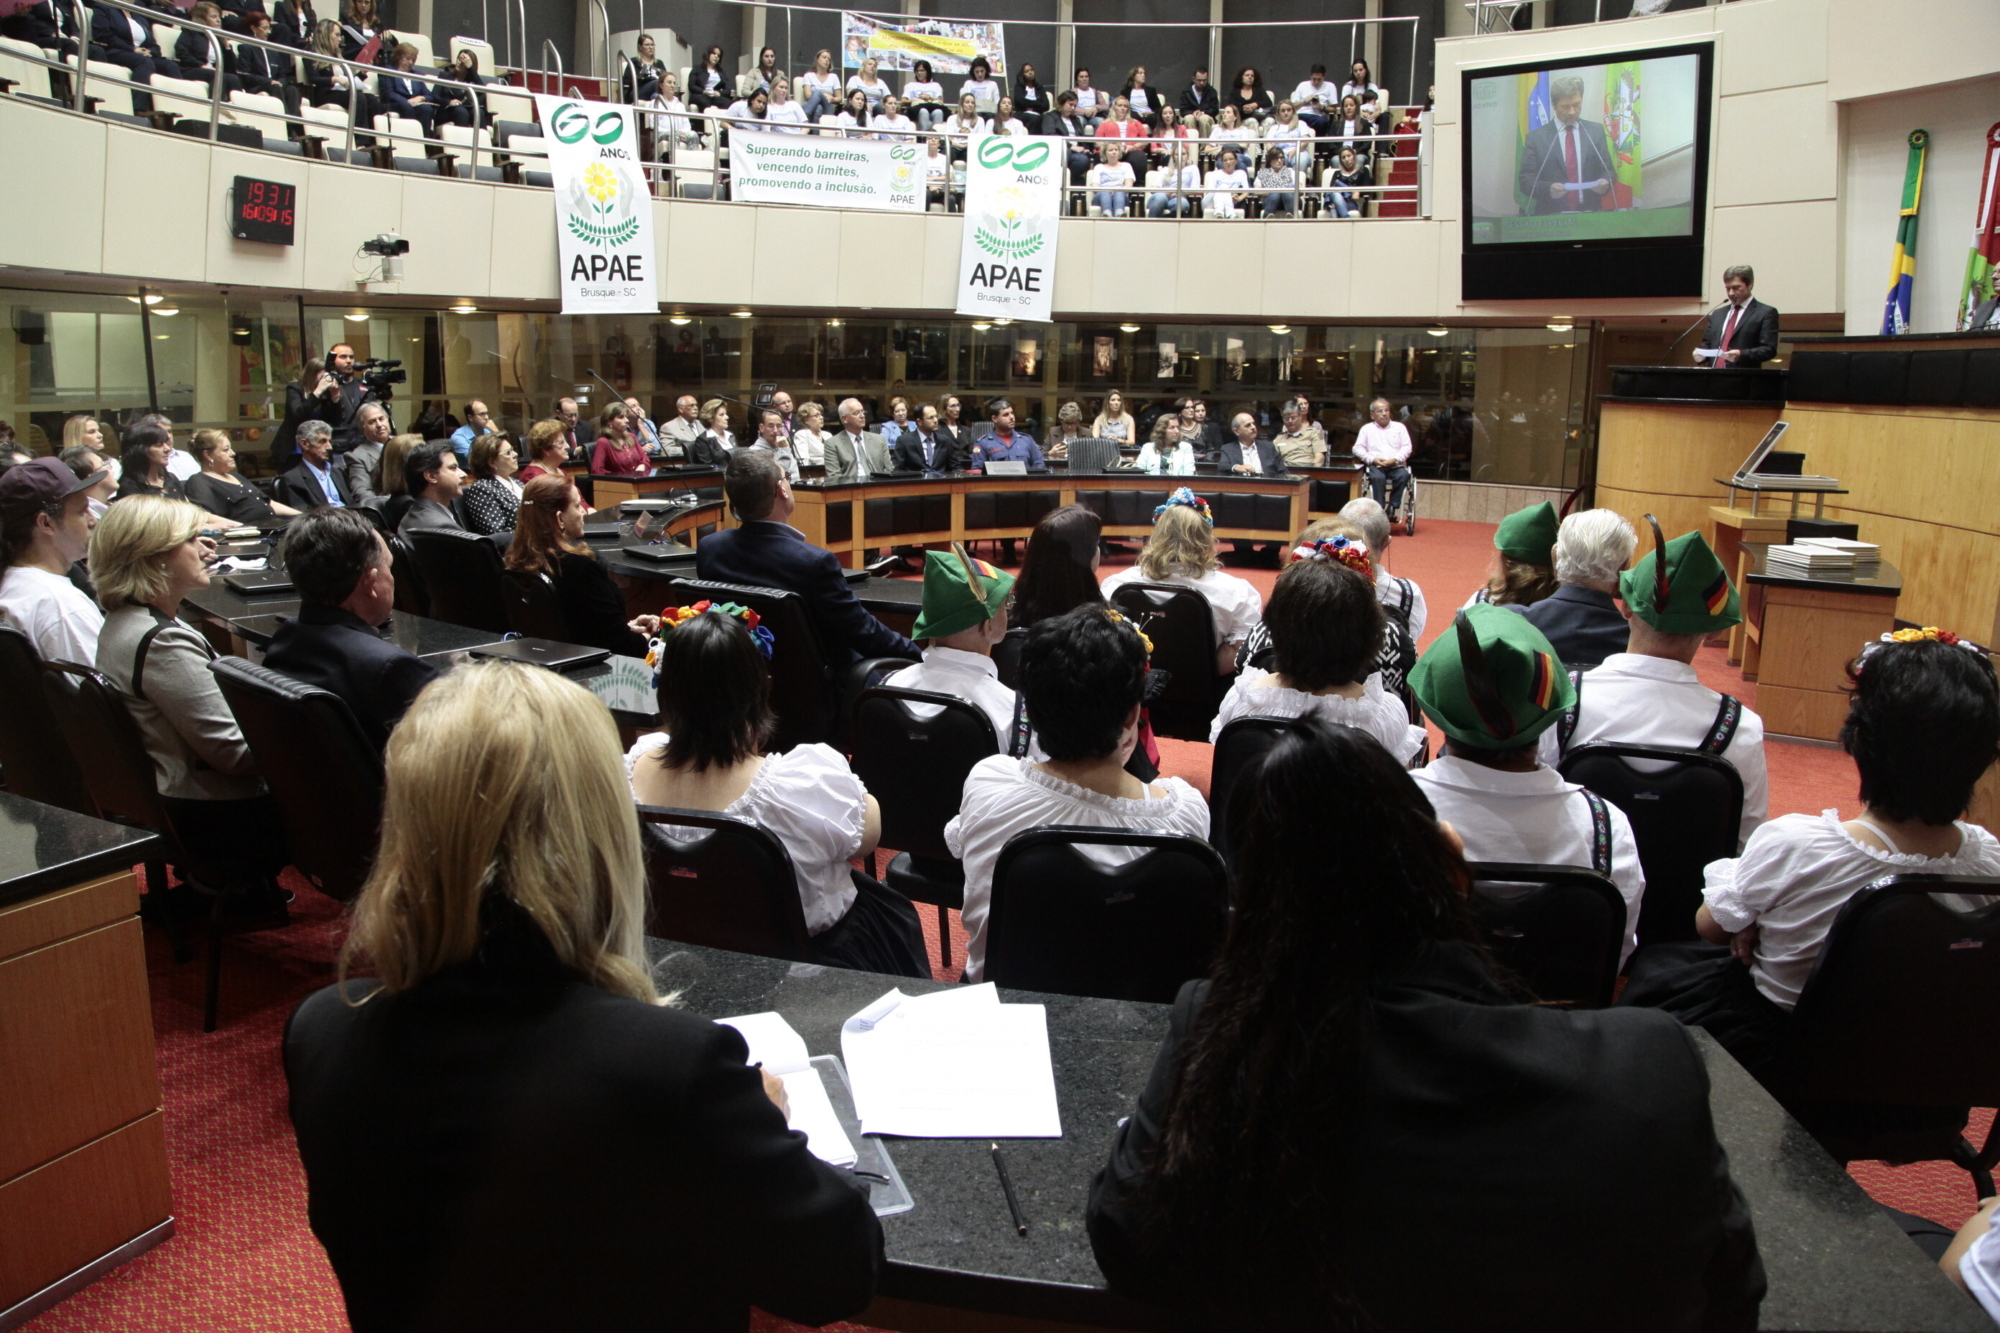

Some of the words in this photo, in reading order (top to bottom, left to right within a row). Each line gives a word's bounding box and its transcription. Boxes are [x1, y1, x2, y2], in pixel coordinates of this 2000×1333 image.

[599, 148, 631, 161] ANOS
[746, 143, 811, 158] Superando
[814, 148, 870, 163] barreiras,
[757, 162, 814, 175] vencendo
[817, 164, 859, 179] limites,
[738, 176, 811, 191] promovendo
[815, 182, 822, 191] a
[825, 180, 877, 195] inclusão.
[1016, 174, 1049, 186] ANOS
[889, 194, 915, 205] APAE
[570, 254, 644, 282] APAE
[969, 262, 1042, 292] APAE
[580, 287, 616, 299] Brusque
[624, 287, 637, 297] SC
[977, 292, 1011, 304] Brusque
[1018, 295, 1032, 306] SC
